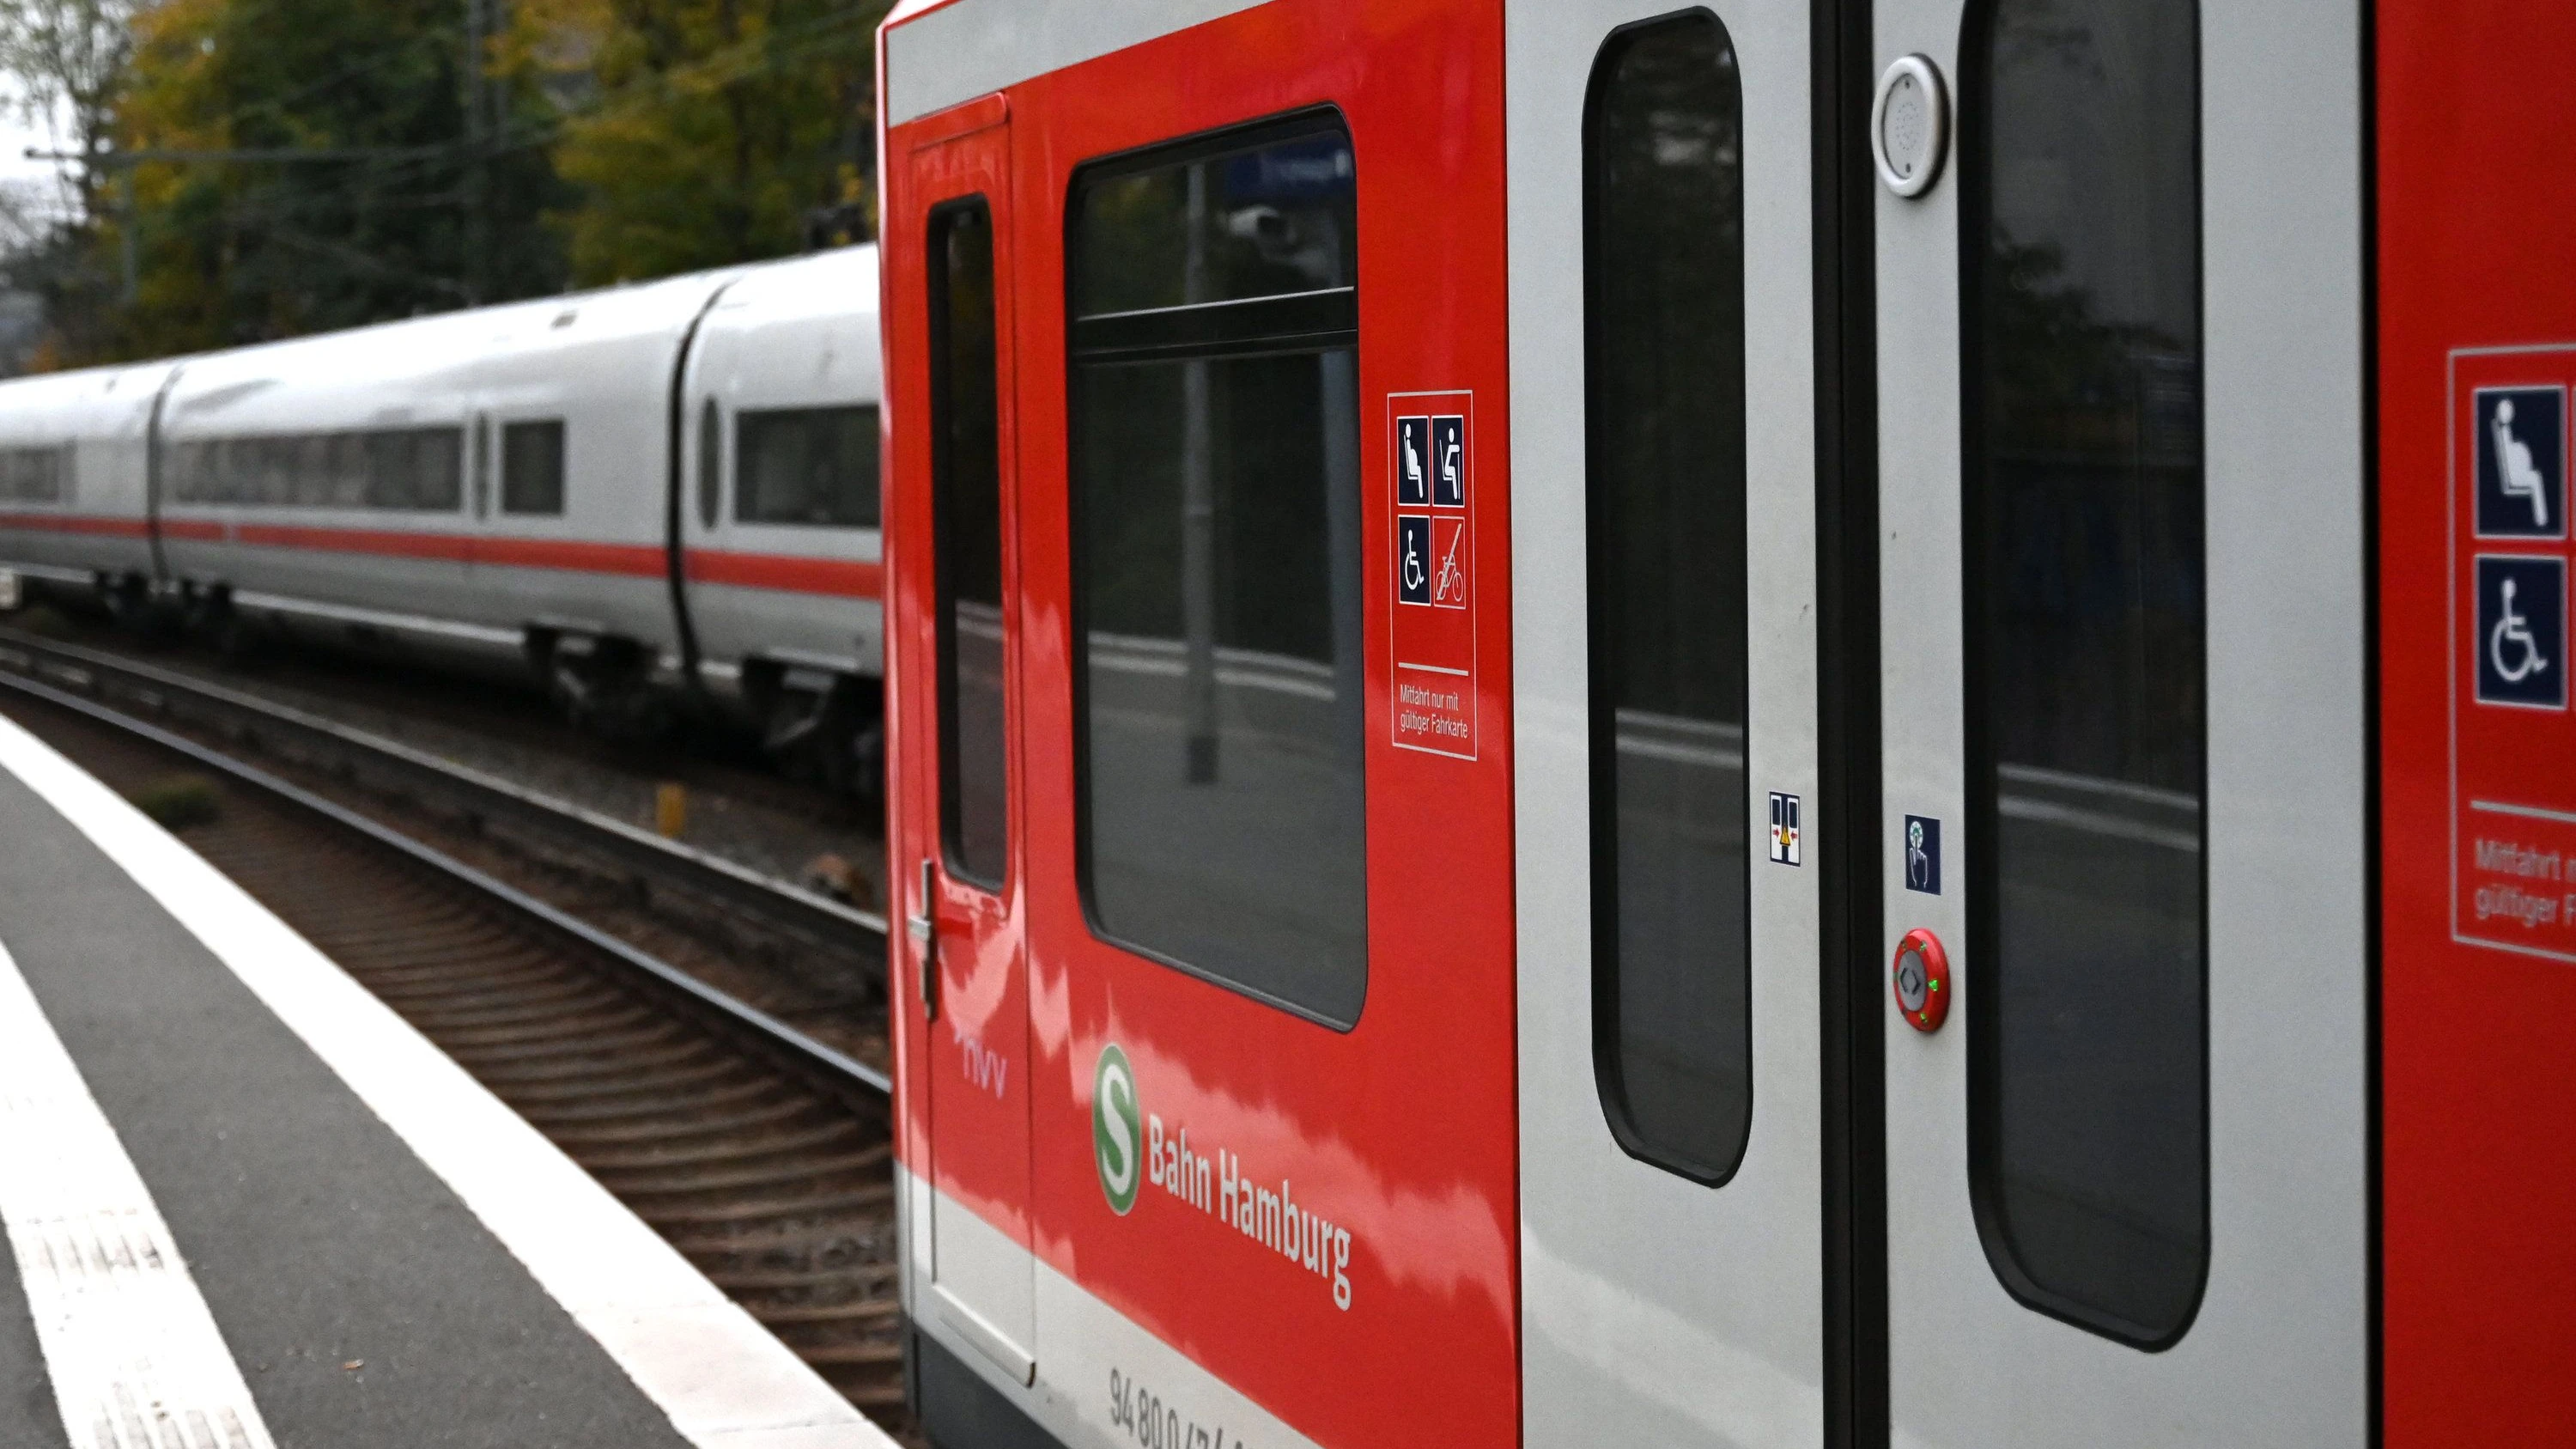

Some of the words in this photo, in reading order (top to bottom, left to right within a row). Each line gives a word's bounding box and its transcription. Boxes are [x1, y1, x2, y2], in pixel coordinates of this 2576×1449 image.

[1400, 684, 1430, 707] Mitfahrt
[1431, 692, 1444, 709] nur
[1446, 691, 1459, 711] mit
[1400, 709, 1430, 735] gültiger
[1431, 713, 1468, 739] Fahrkarte
[1100, 1062, 1133, 1196] S
[1148, 1112, 1212, 1215] Bahn
[1218, 1147, 1352, 1312] Hamburg
